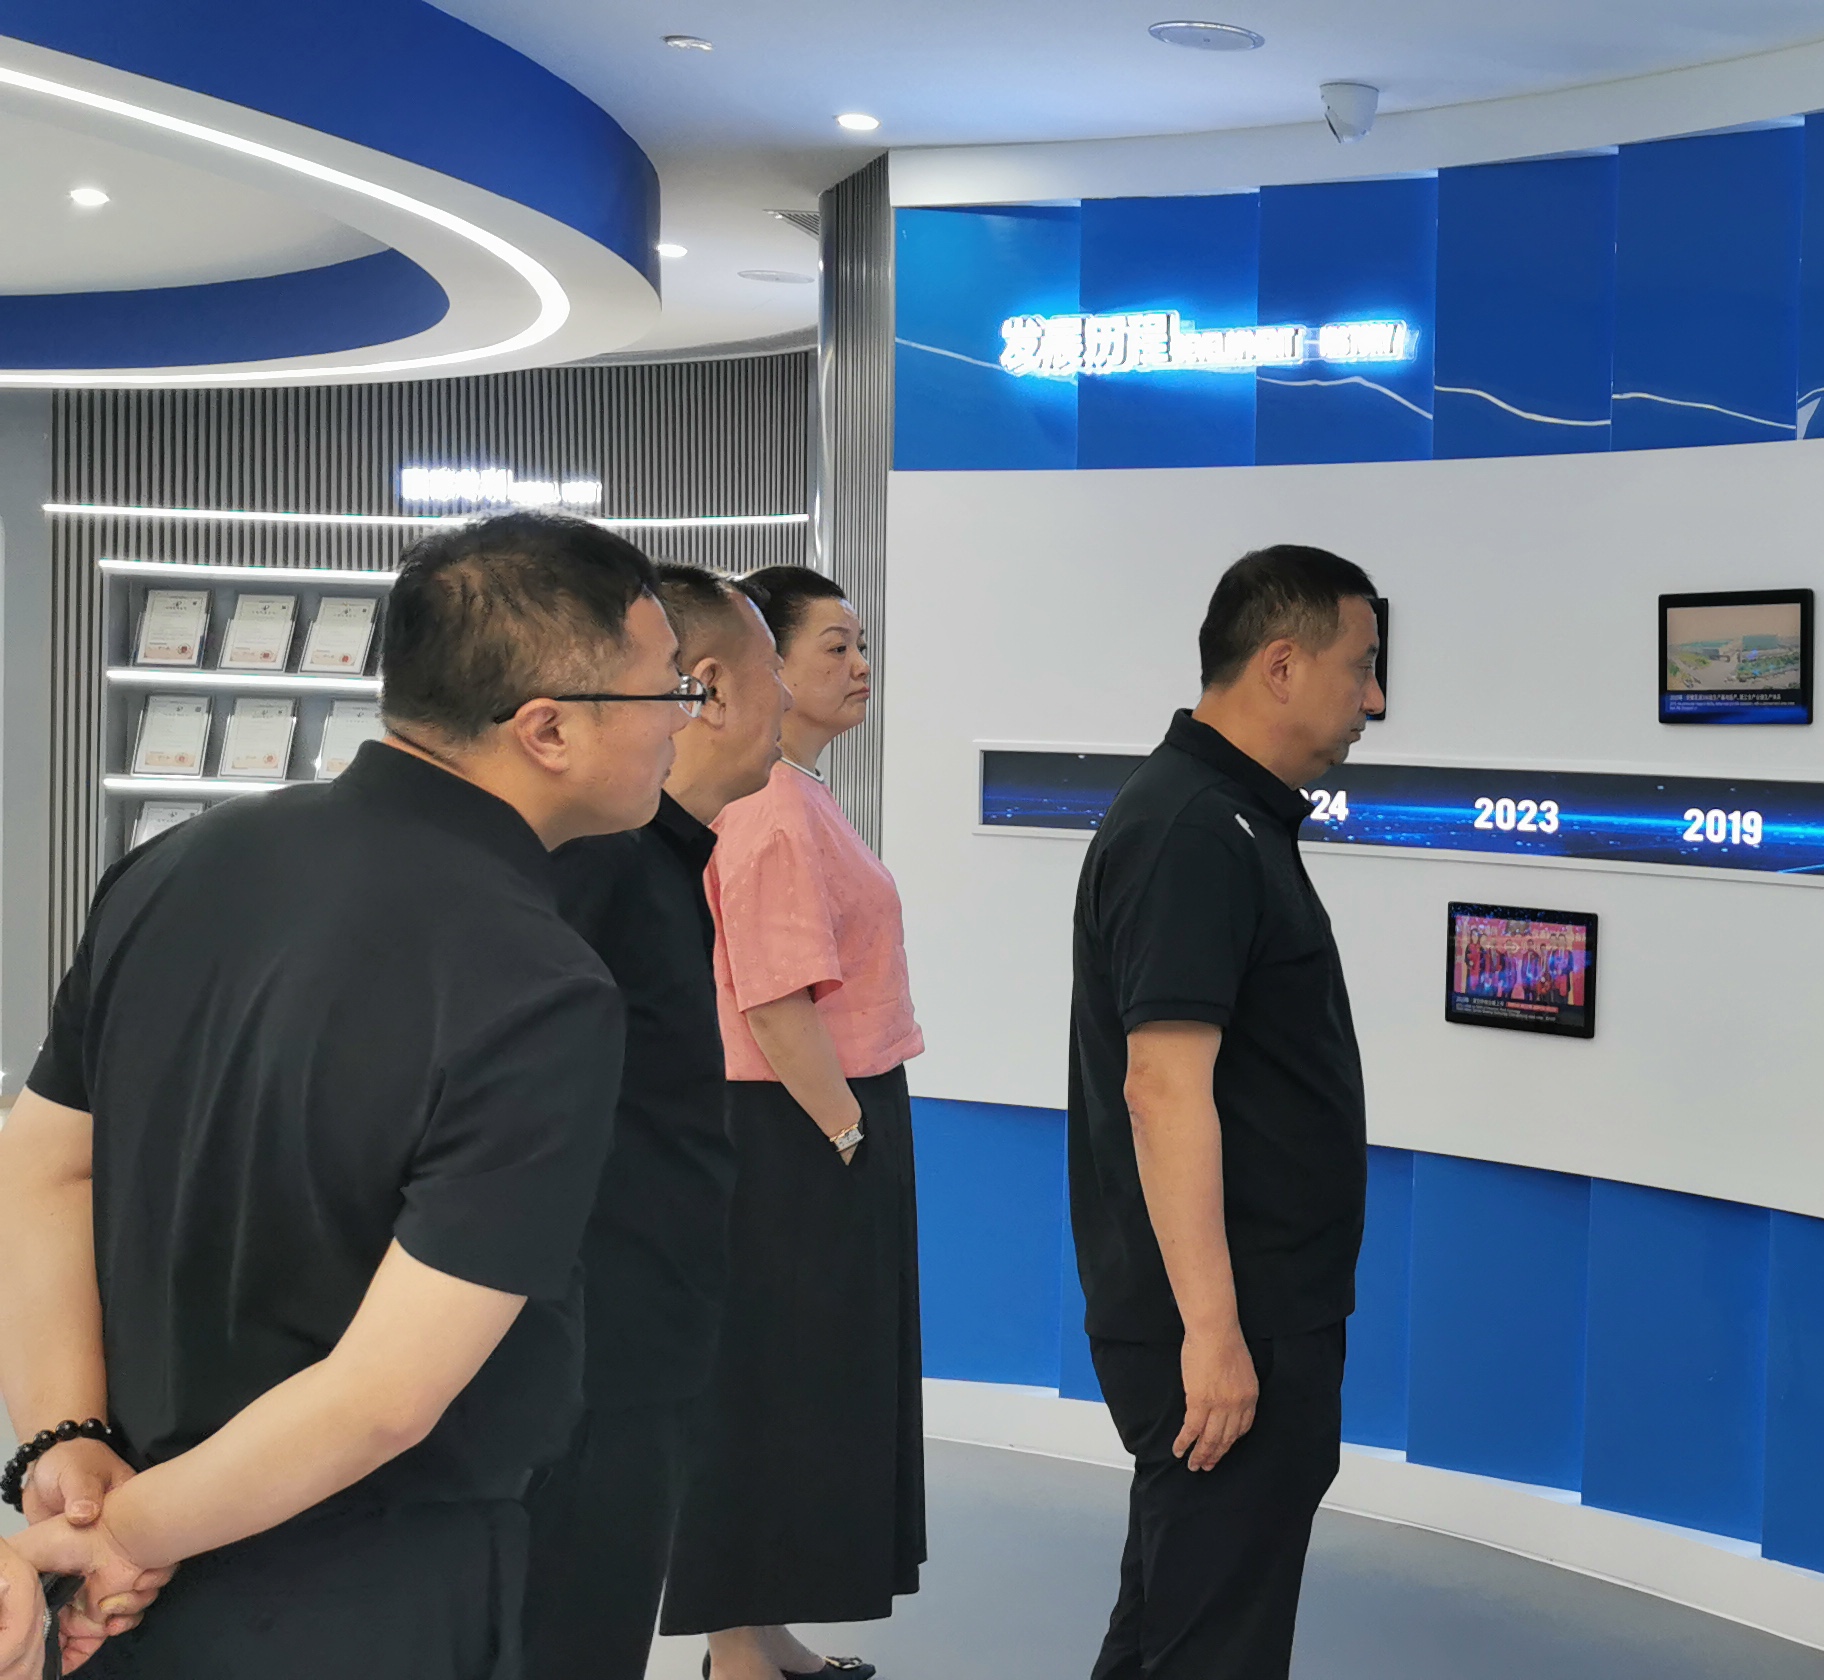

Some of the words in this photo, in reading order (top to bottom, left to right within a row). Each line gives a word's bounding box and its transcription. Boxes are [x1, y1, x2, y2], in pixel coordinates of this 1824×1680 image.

[1000, 313, 1170, 373] 发展历程
[1298, 788, 1349, 821] 24
[1474, 797, 1560, 834] 2023
[1683, 808, 1763, 845] 2019
